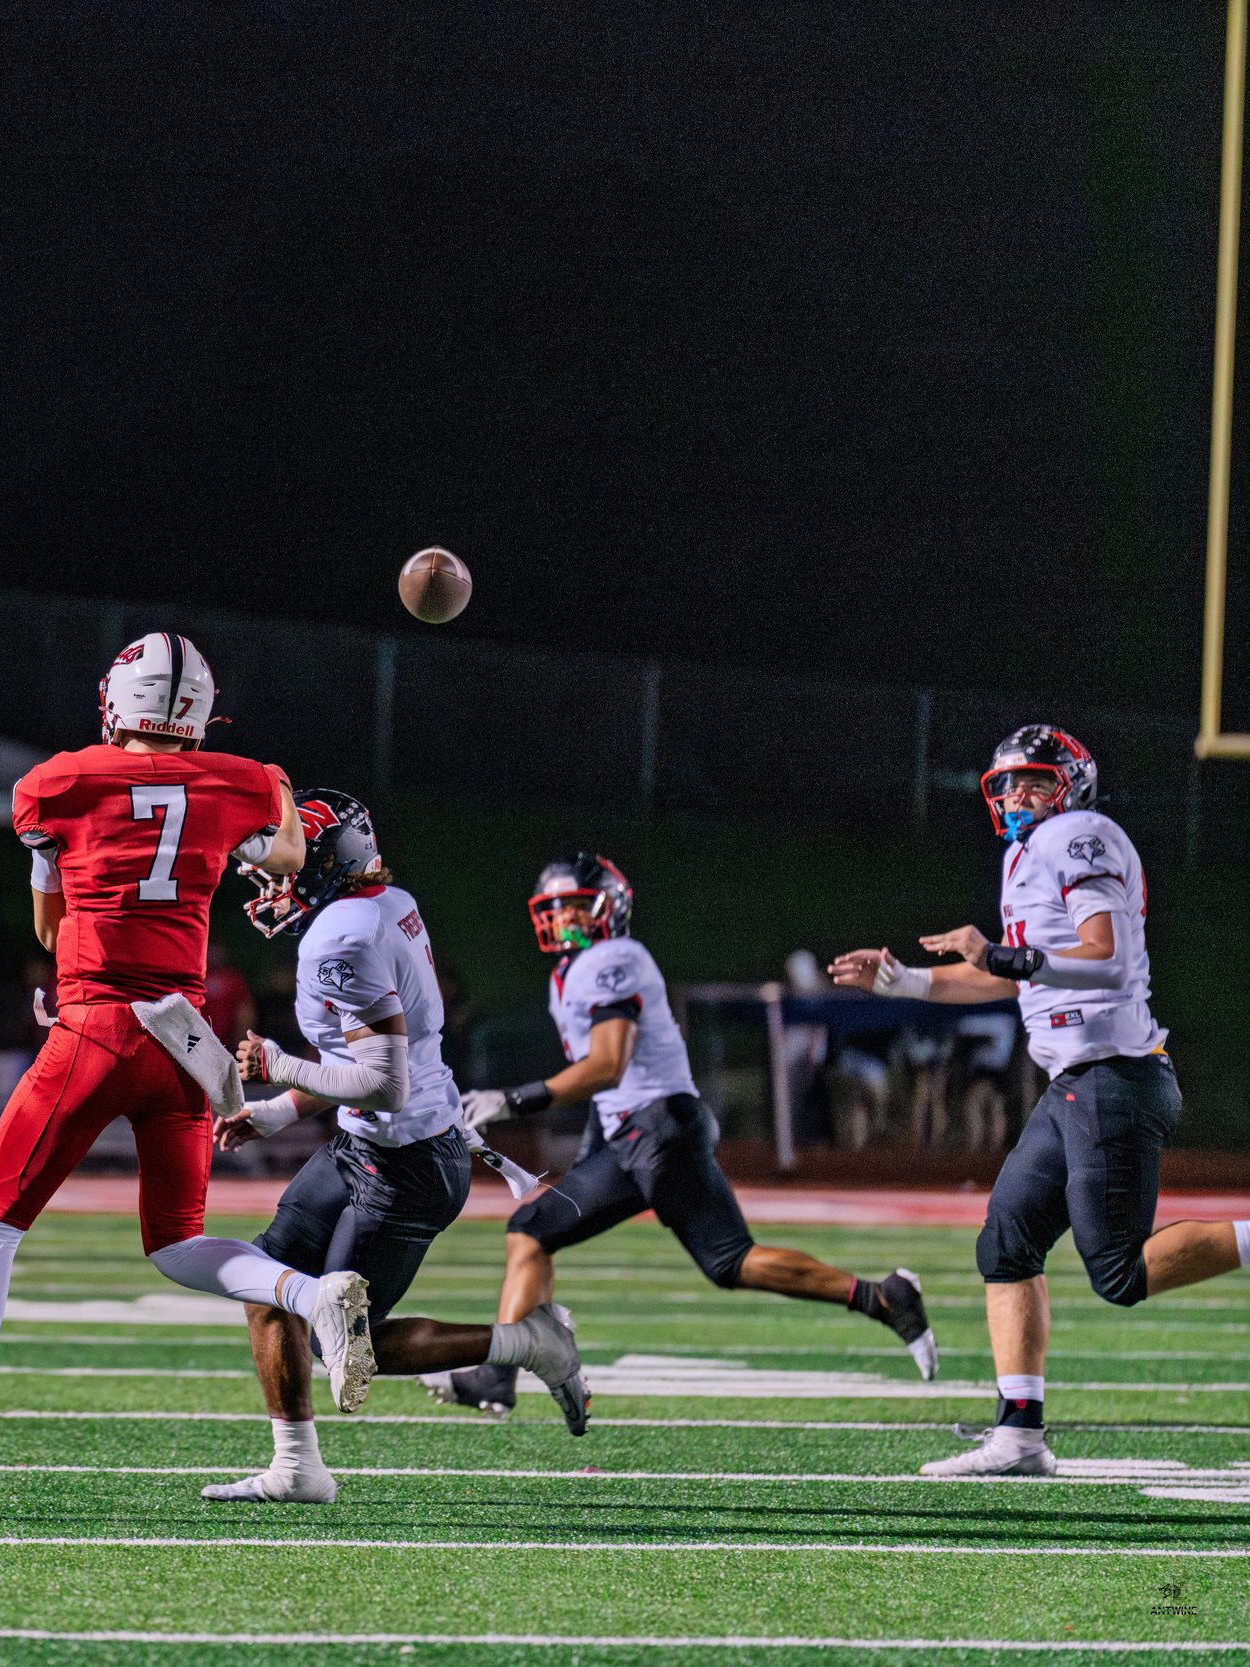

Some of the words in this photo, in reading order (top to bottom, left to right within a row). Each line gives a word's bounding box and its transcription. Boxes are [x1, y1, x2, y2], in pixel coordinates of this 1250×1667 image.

[174, 696, 194, 720] 7
[139, 718, 195, 737] Riddell
[128, 784, 188, 902] 7
